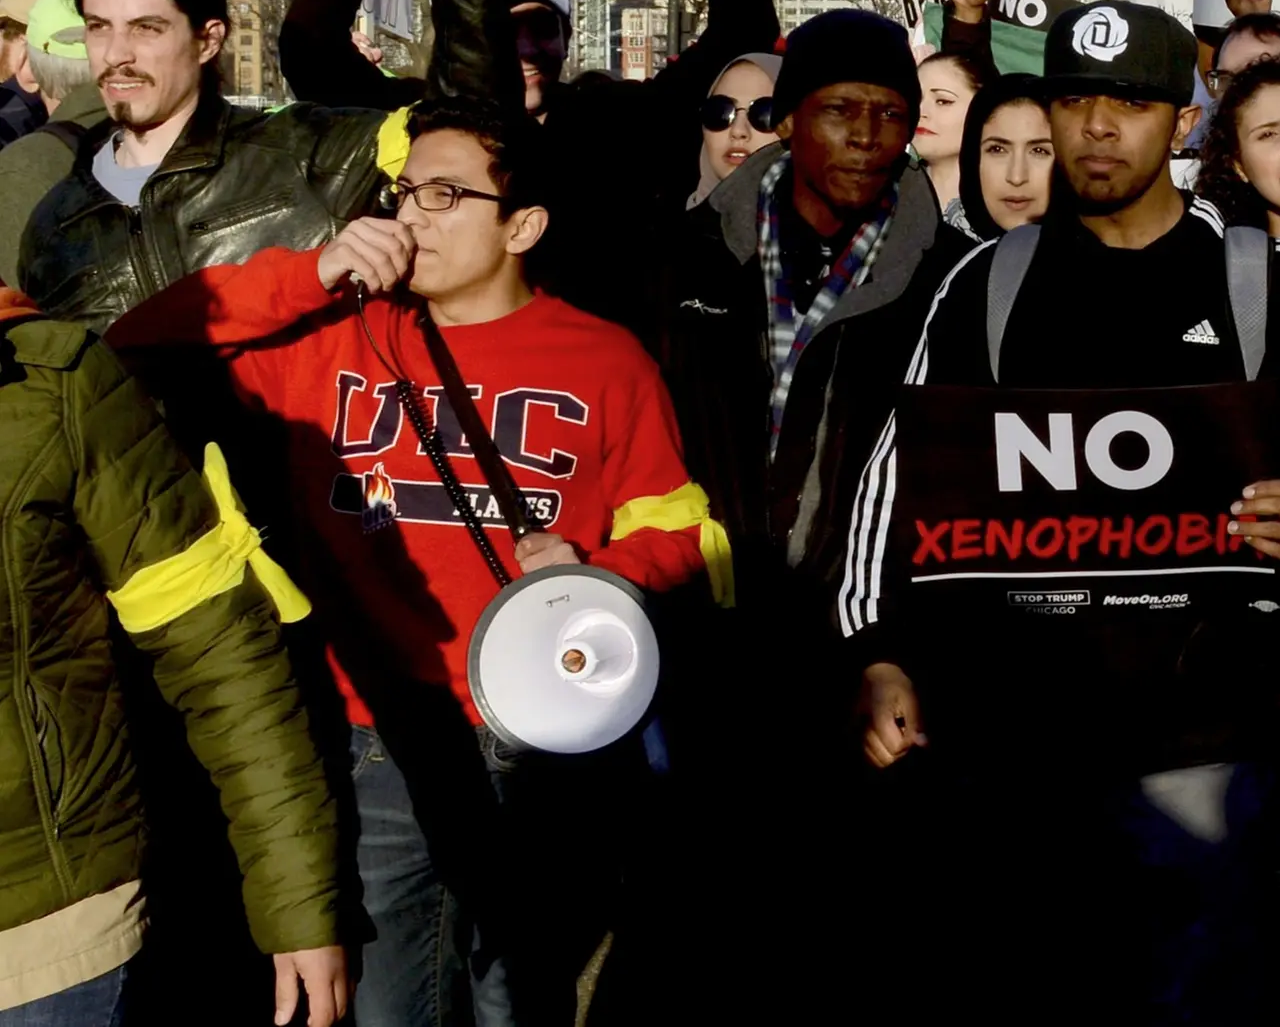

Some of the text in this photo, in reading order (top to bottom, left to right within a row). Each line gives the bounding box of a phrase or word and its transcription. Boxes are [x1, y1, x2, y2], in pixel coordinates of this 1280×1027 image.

[1182, 333, 1220, 345] adidas
[330, 370, 589, 479] UIC
[994, 410, 1174, 492] NO
[1014, 593, 1085, 603] STOP TRUMP
[1103, 594, 1189, 606] MoveOn.ORG
[1025, 606, 1076, 615] CHICAGO
